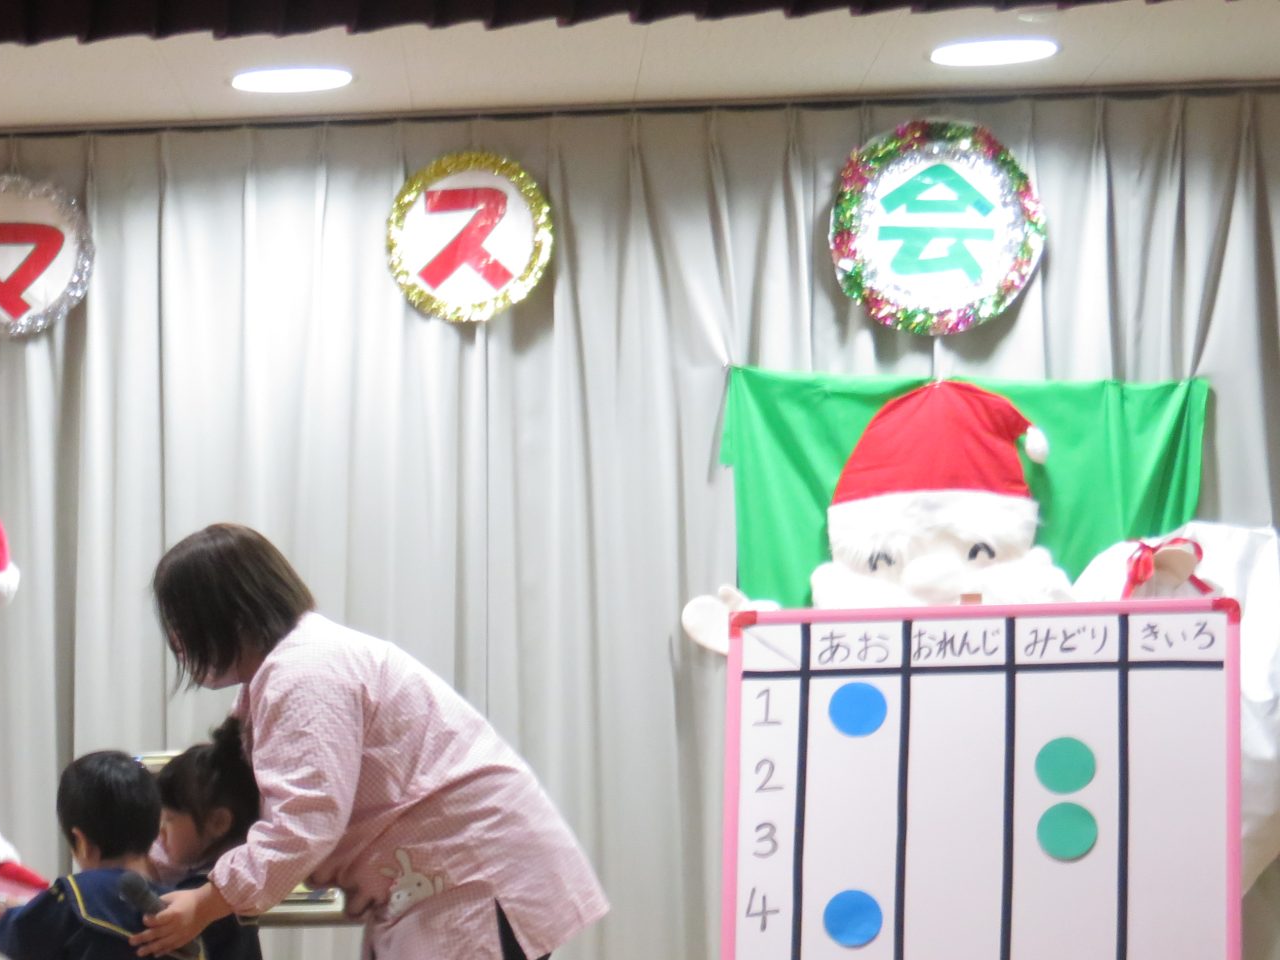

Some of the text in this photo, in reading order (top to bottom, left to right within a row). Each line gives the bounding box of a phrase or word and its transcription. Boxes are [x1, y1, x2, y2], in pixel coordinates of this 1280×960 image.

[418, 188, 515, 292] ス
[877, 162, 994, 282] 会
[818, 629, 889, 665] あお
[912, 628, 1000, 662] おれんじ
[1023, 626, 1108, 659] みどり
[1141, 620, 1216, 652] きいろ
[753, 688, 782, 727] 1
[755, 758, 783, 793] 2
[753, 822, 779, 859] 3
[745, 887, 780, 932] 4
